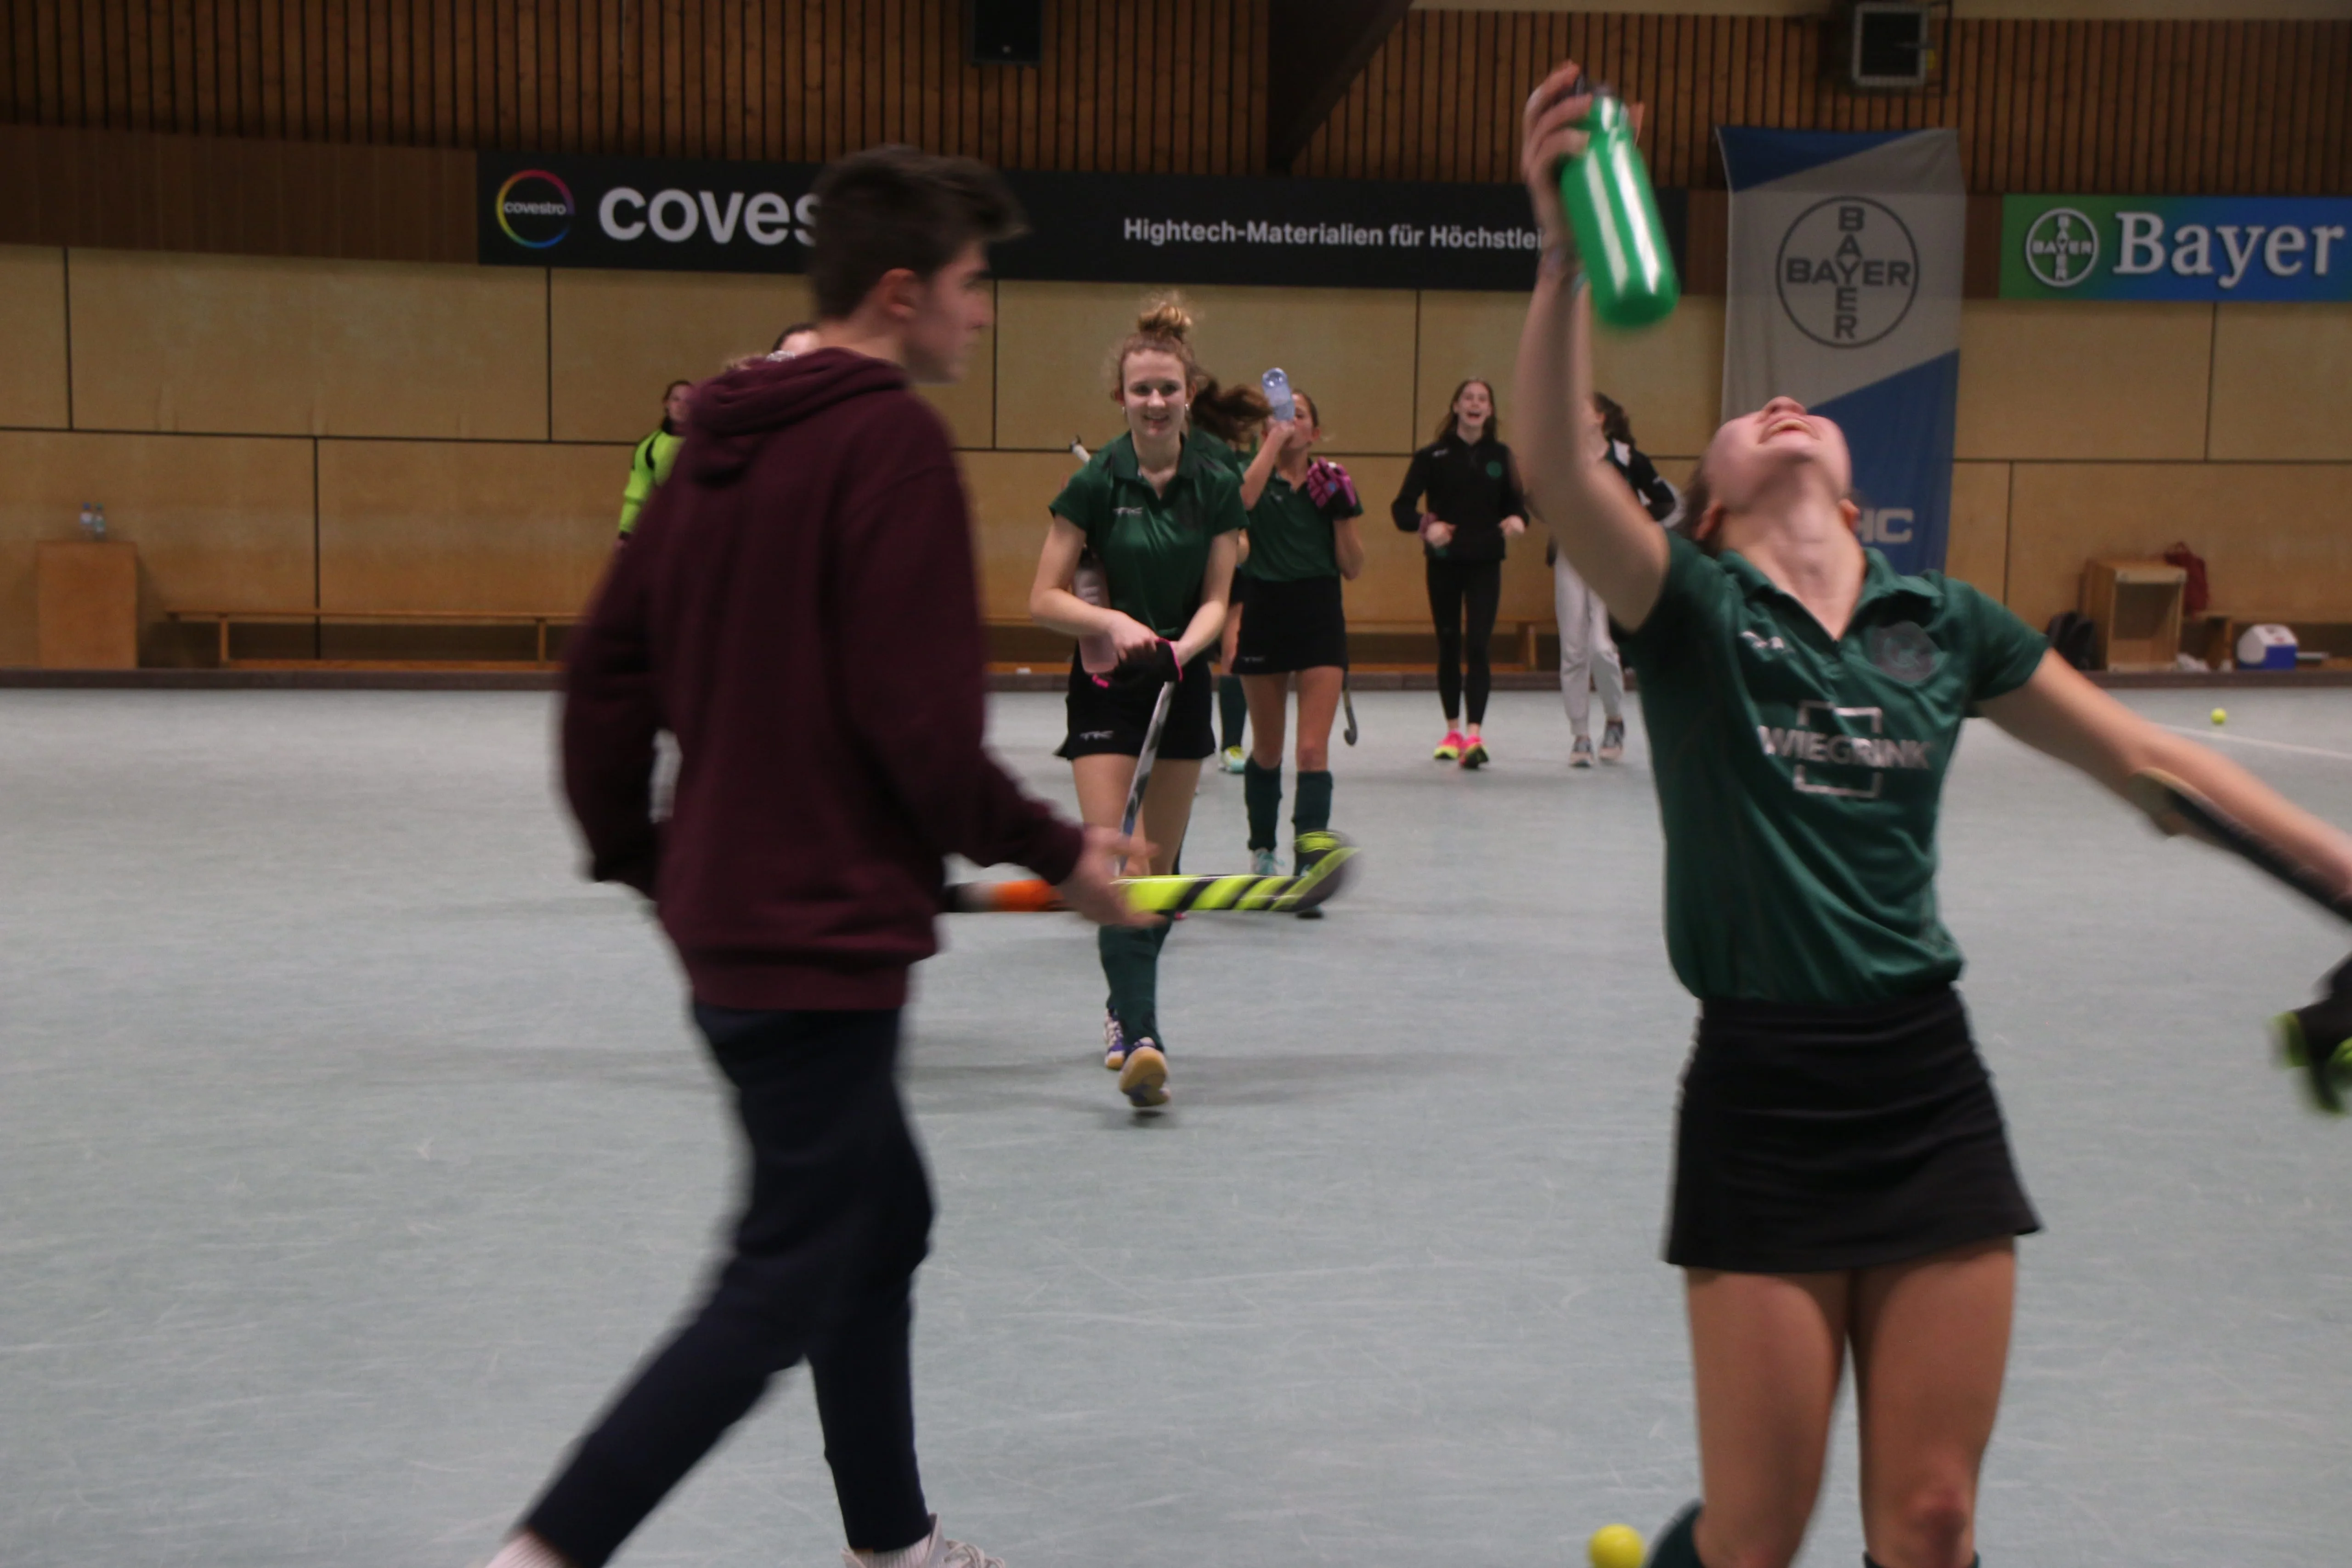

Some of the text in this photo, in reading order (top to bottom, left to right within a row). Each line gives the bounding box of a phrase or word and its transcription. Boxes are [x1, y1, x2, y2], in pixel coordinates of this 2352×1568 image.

[504, 201, 567, 216] covestro
[1124, 217, 1384, 247] Hightech-Materialien
[1388, 223, 1425, 247] für
[2113, 211, 2345, 288] Bayer
[1786, 257, 1911, 287] BAYER
[1835, 206, 1865, 339] BAYER
